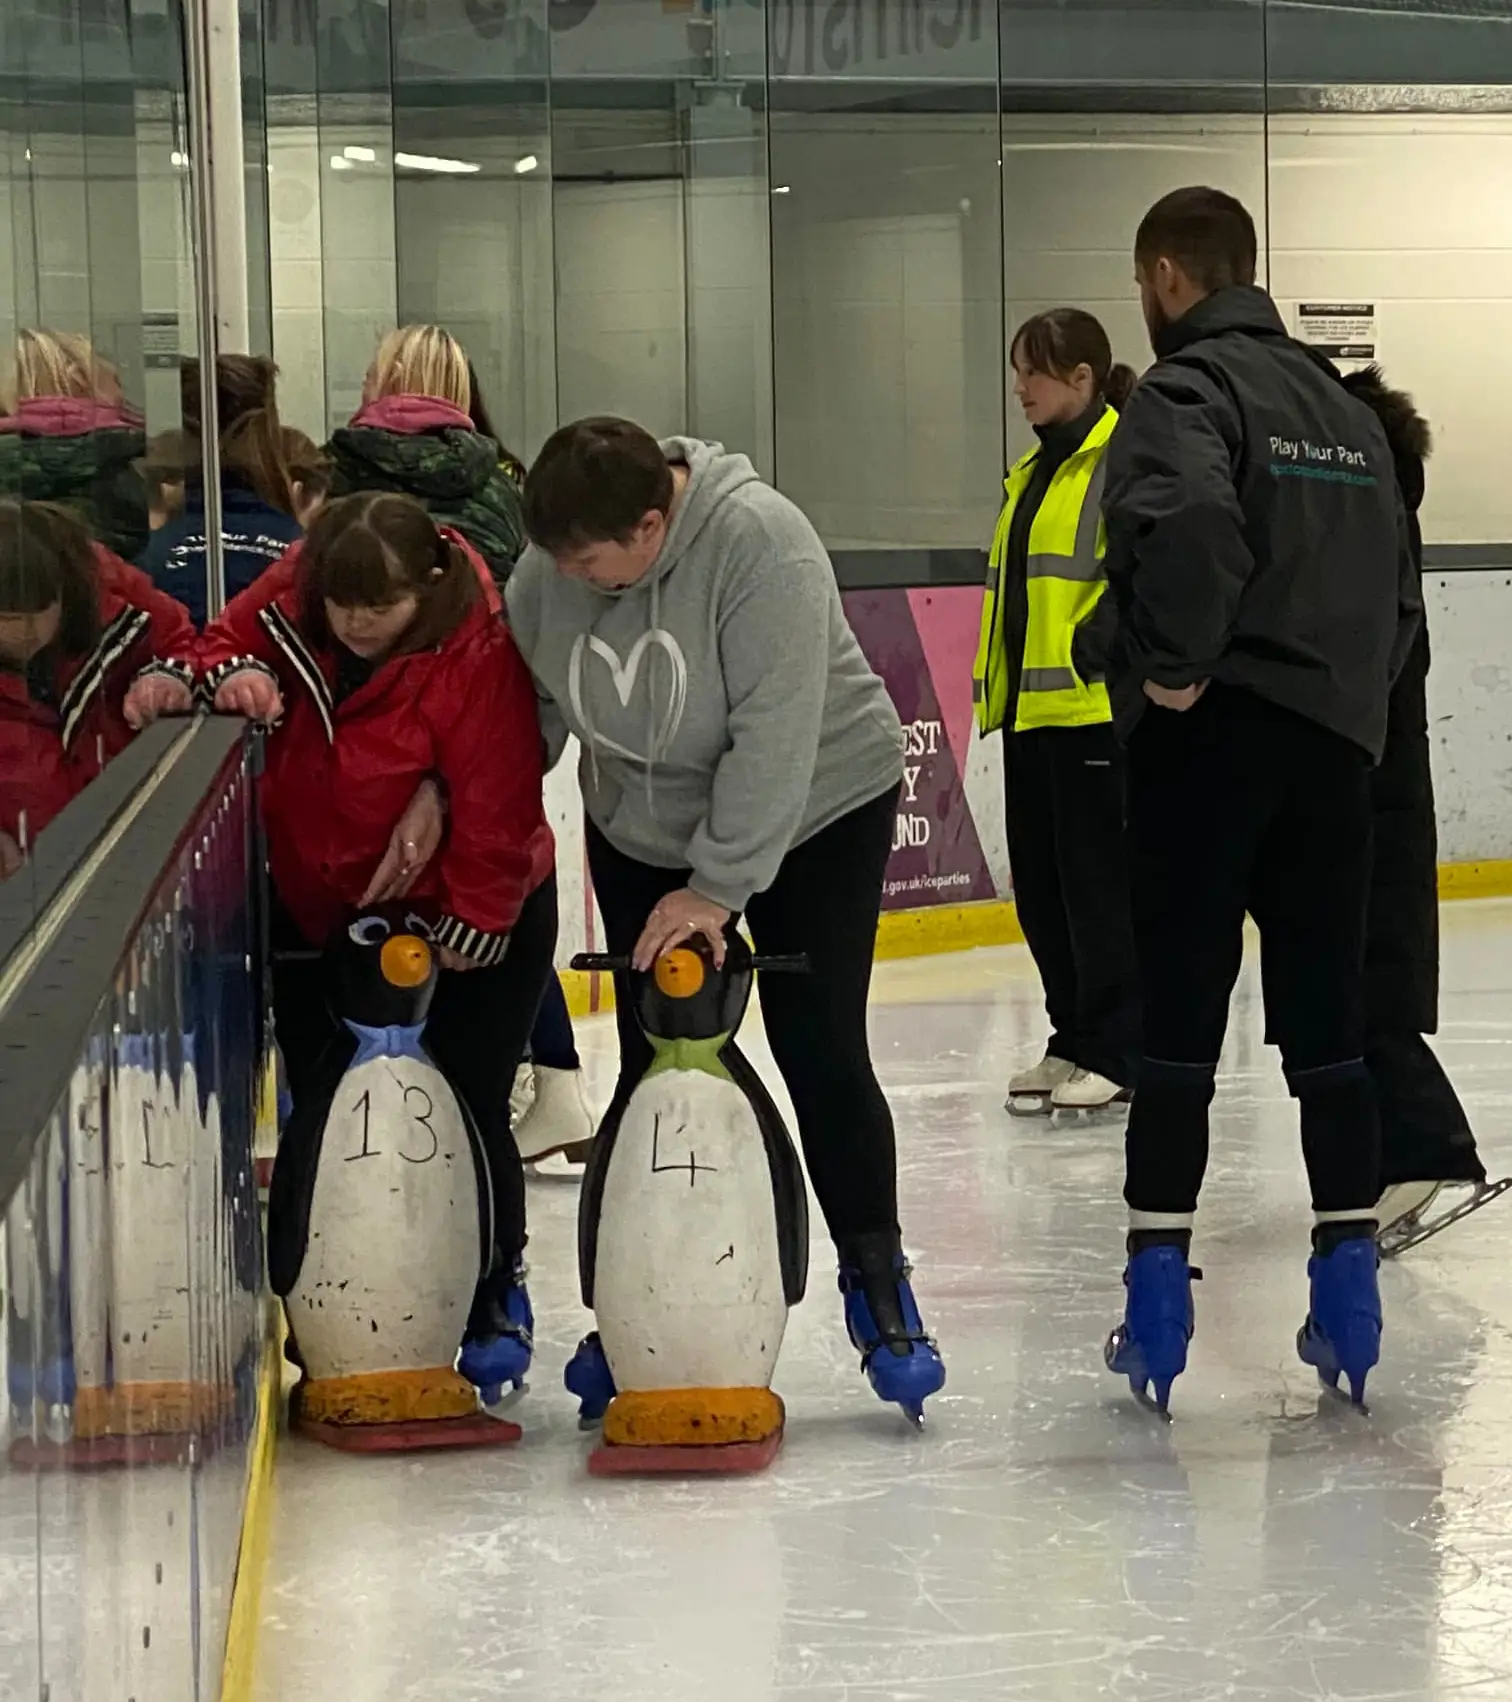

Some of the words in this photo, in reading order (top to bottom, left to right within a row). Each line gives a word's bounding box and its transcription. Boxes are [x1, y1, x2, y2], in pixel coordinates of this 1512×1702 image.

[1269, 436, 1298, 460] Play
[1301, 439, 1334, 461] Your
[1337, 446, 1367, 467] Part
[901, 720, 941, 756] EST
[344, 1087, 438, 1163] 13
[652, 1110, 718, 1187] 4
